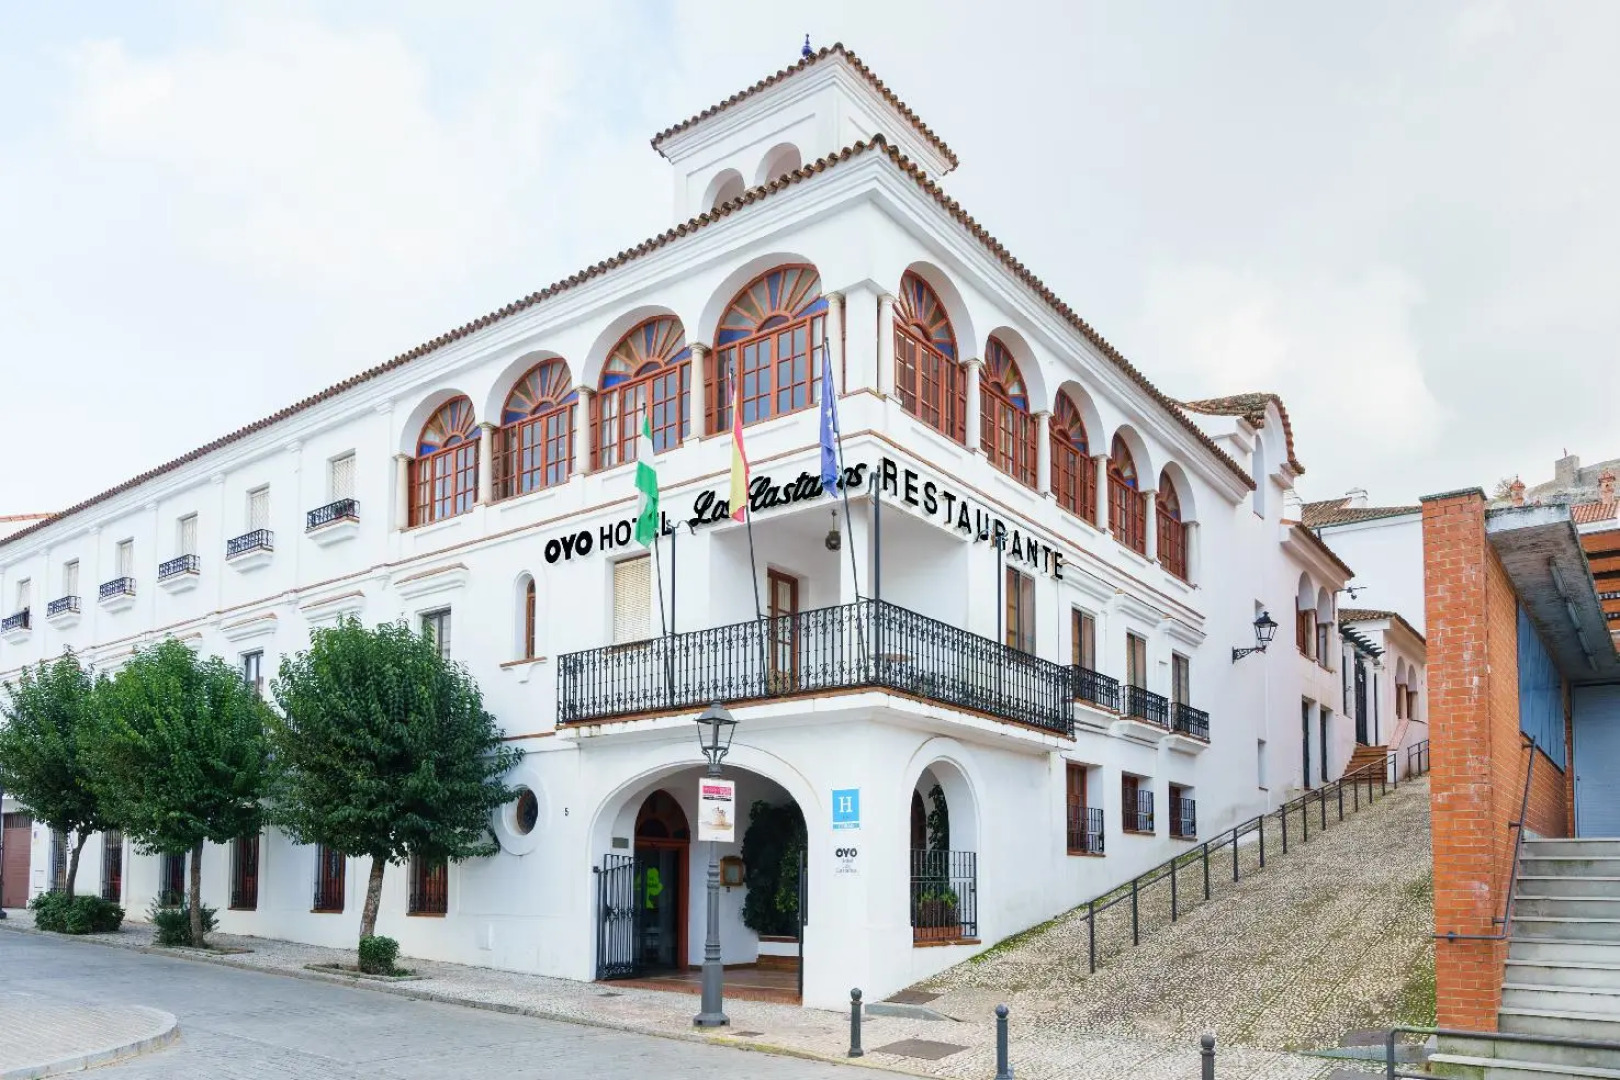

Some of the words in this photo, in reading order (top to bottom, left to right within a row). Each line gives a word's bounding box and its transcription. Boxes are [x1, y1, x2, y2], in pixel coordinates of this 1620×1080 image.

[544, 530, 593, 564] OYO
[600, 510, 673, 551] HOL
[748, 462, 868, 513] Castaos
[882, 456, 1064, 580] RESTAURANTE
[838, 796, 853, 813] H
[835, 848, 858, 858] OYO
